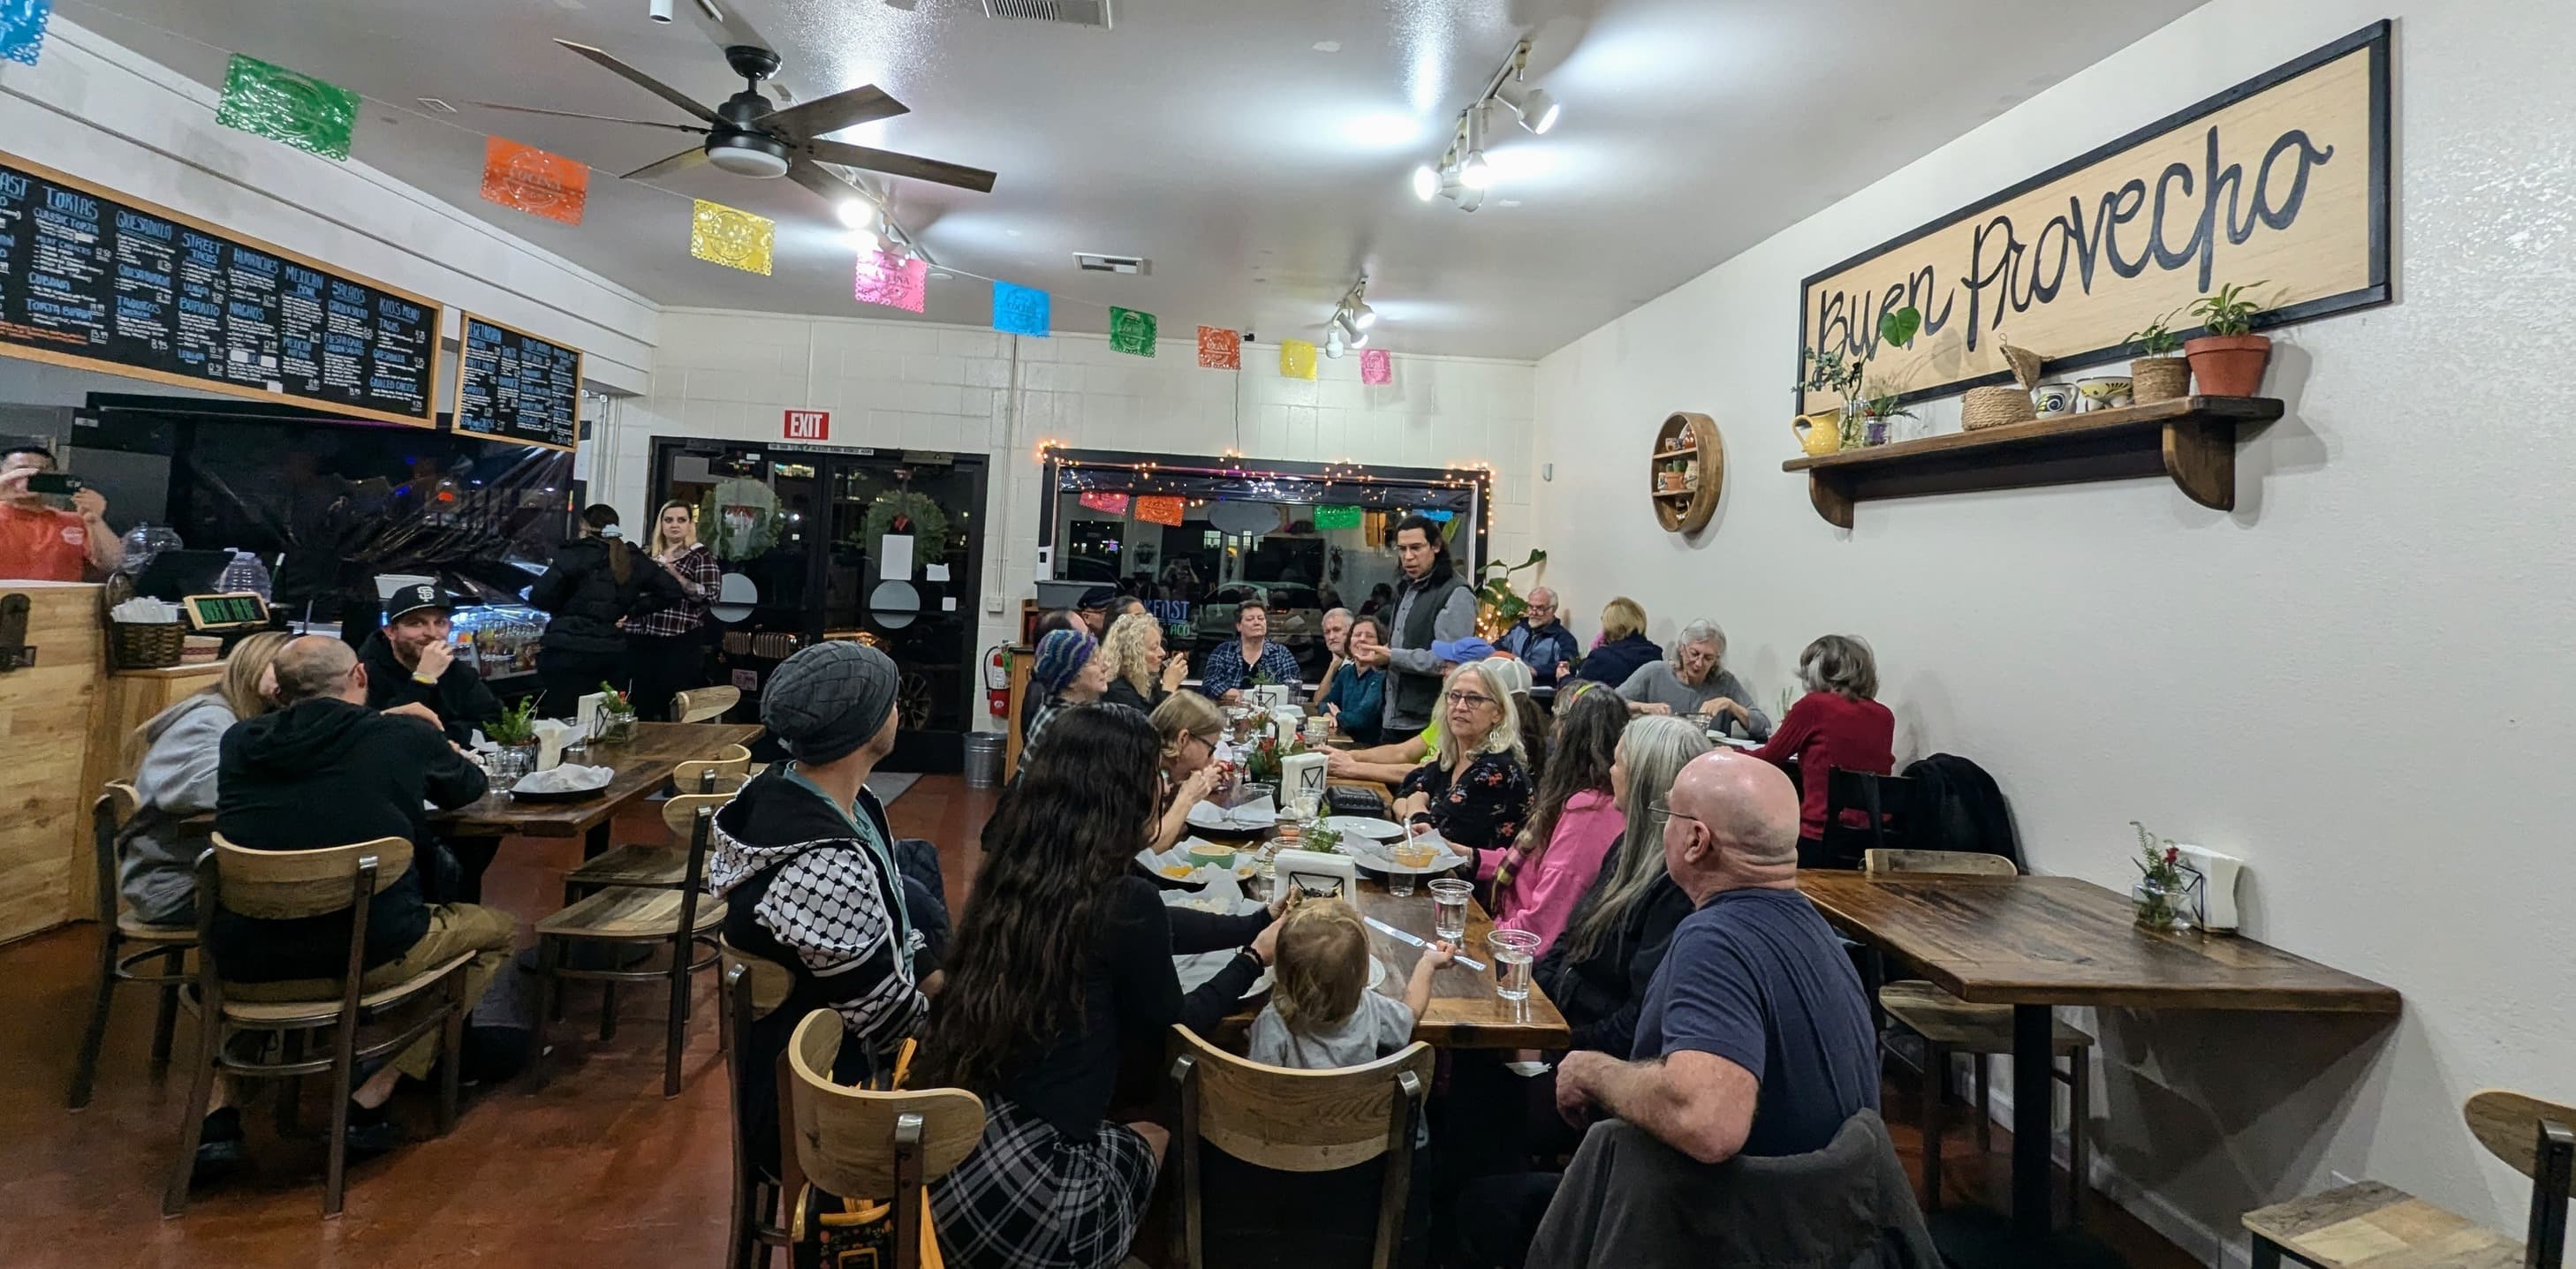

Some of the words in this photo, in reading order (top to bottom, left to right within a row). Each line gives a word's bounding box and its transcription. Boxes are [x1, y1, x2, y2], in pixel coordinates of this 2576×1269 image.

[0, 172, 32, 197] AST
[42, 185, 98, 220] TORTAS
[116, 210, 171, 240] QUESADILLA
[182, 232, 224, 254] STREET
[191, 248, 218, 264] TACOS
[1813, 265, 1954, 391] Buen
[1961, 125, 2333, 351] Provecho
[285, 265, 323, 290] MEXICAN
[332, 281, 365, 303] SALADS
[229, 301, 265, 321] NACHOS
[379, 297, 401, 315] KIDS
[402, 304, 420, 321] MENU
[791, 412, 822, 438] EXIT
[417, 585, 435, 602] SF
[1144, 600, 1189, 619] KFAST
[1170, 623, 1190, 637] ACO
